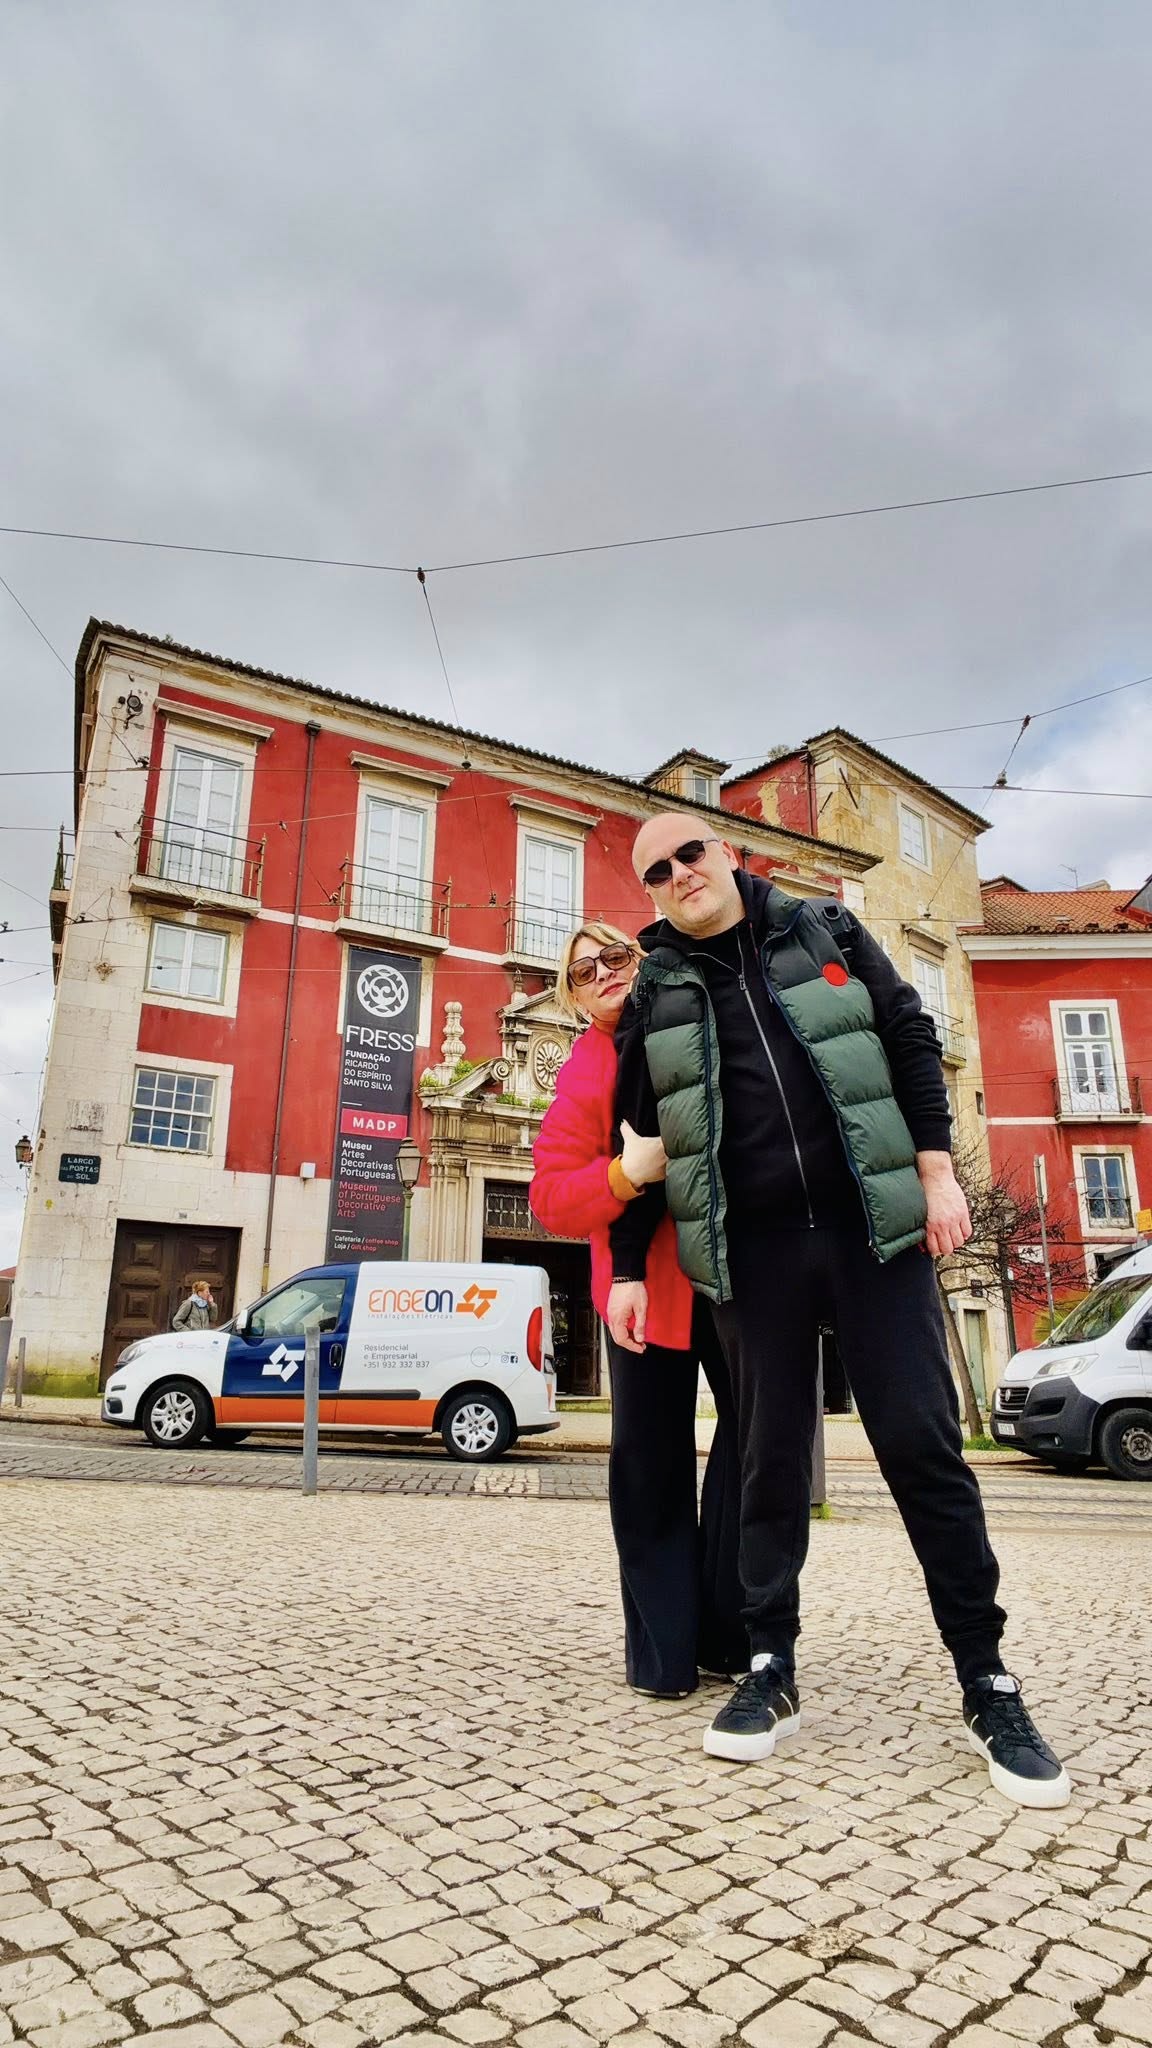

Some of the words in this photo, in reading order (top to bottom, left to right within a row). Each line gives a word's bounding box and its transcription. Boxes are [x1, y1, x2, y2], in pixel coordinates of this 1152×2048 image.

[346, 1024, 414, 1052] FRESS
[346, 1050, 390, 1062] FUNDAÇÃO
[345, 1059, 379, 1070] RICARDO
[357, 1070, 391, 1081] ESPÍRITO
[343, 1078, 370, 1088] SANTO
[371, 1082, 393, 1091] SILVA
[353, 1116, 396, 1132] MADP
[342, 1140, 372, 1150] Museu
[341, 1149, 365, 1159] Artes
[67, 1157, 93, 1165] LARGO
[341, 1158, 394, 1170] Decorativas
[69, 1165, 99, 1173] PORTAS
[340, 1167, 396, 1179] Portuguesas
[75, 1172, 91, 1180] SOL
[340, 1181, 378, 1192] Museum
[350, 1191, 400, 1203] Portuguese
[338, 1199, 386, 1211] Decorative
[337, 1209, 356, 1218] Arts
[371, 1352, 418, 1360] Empresarial
